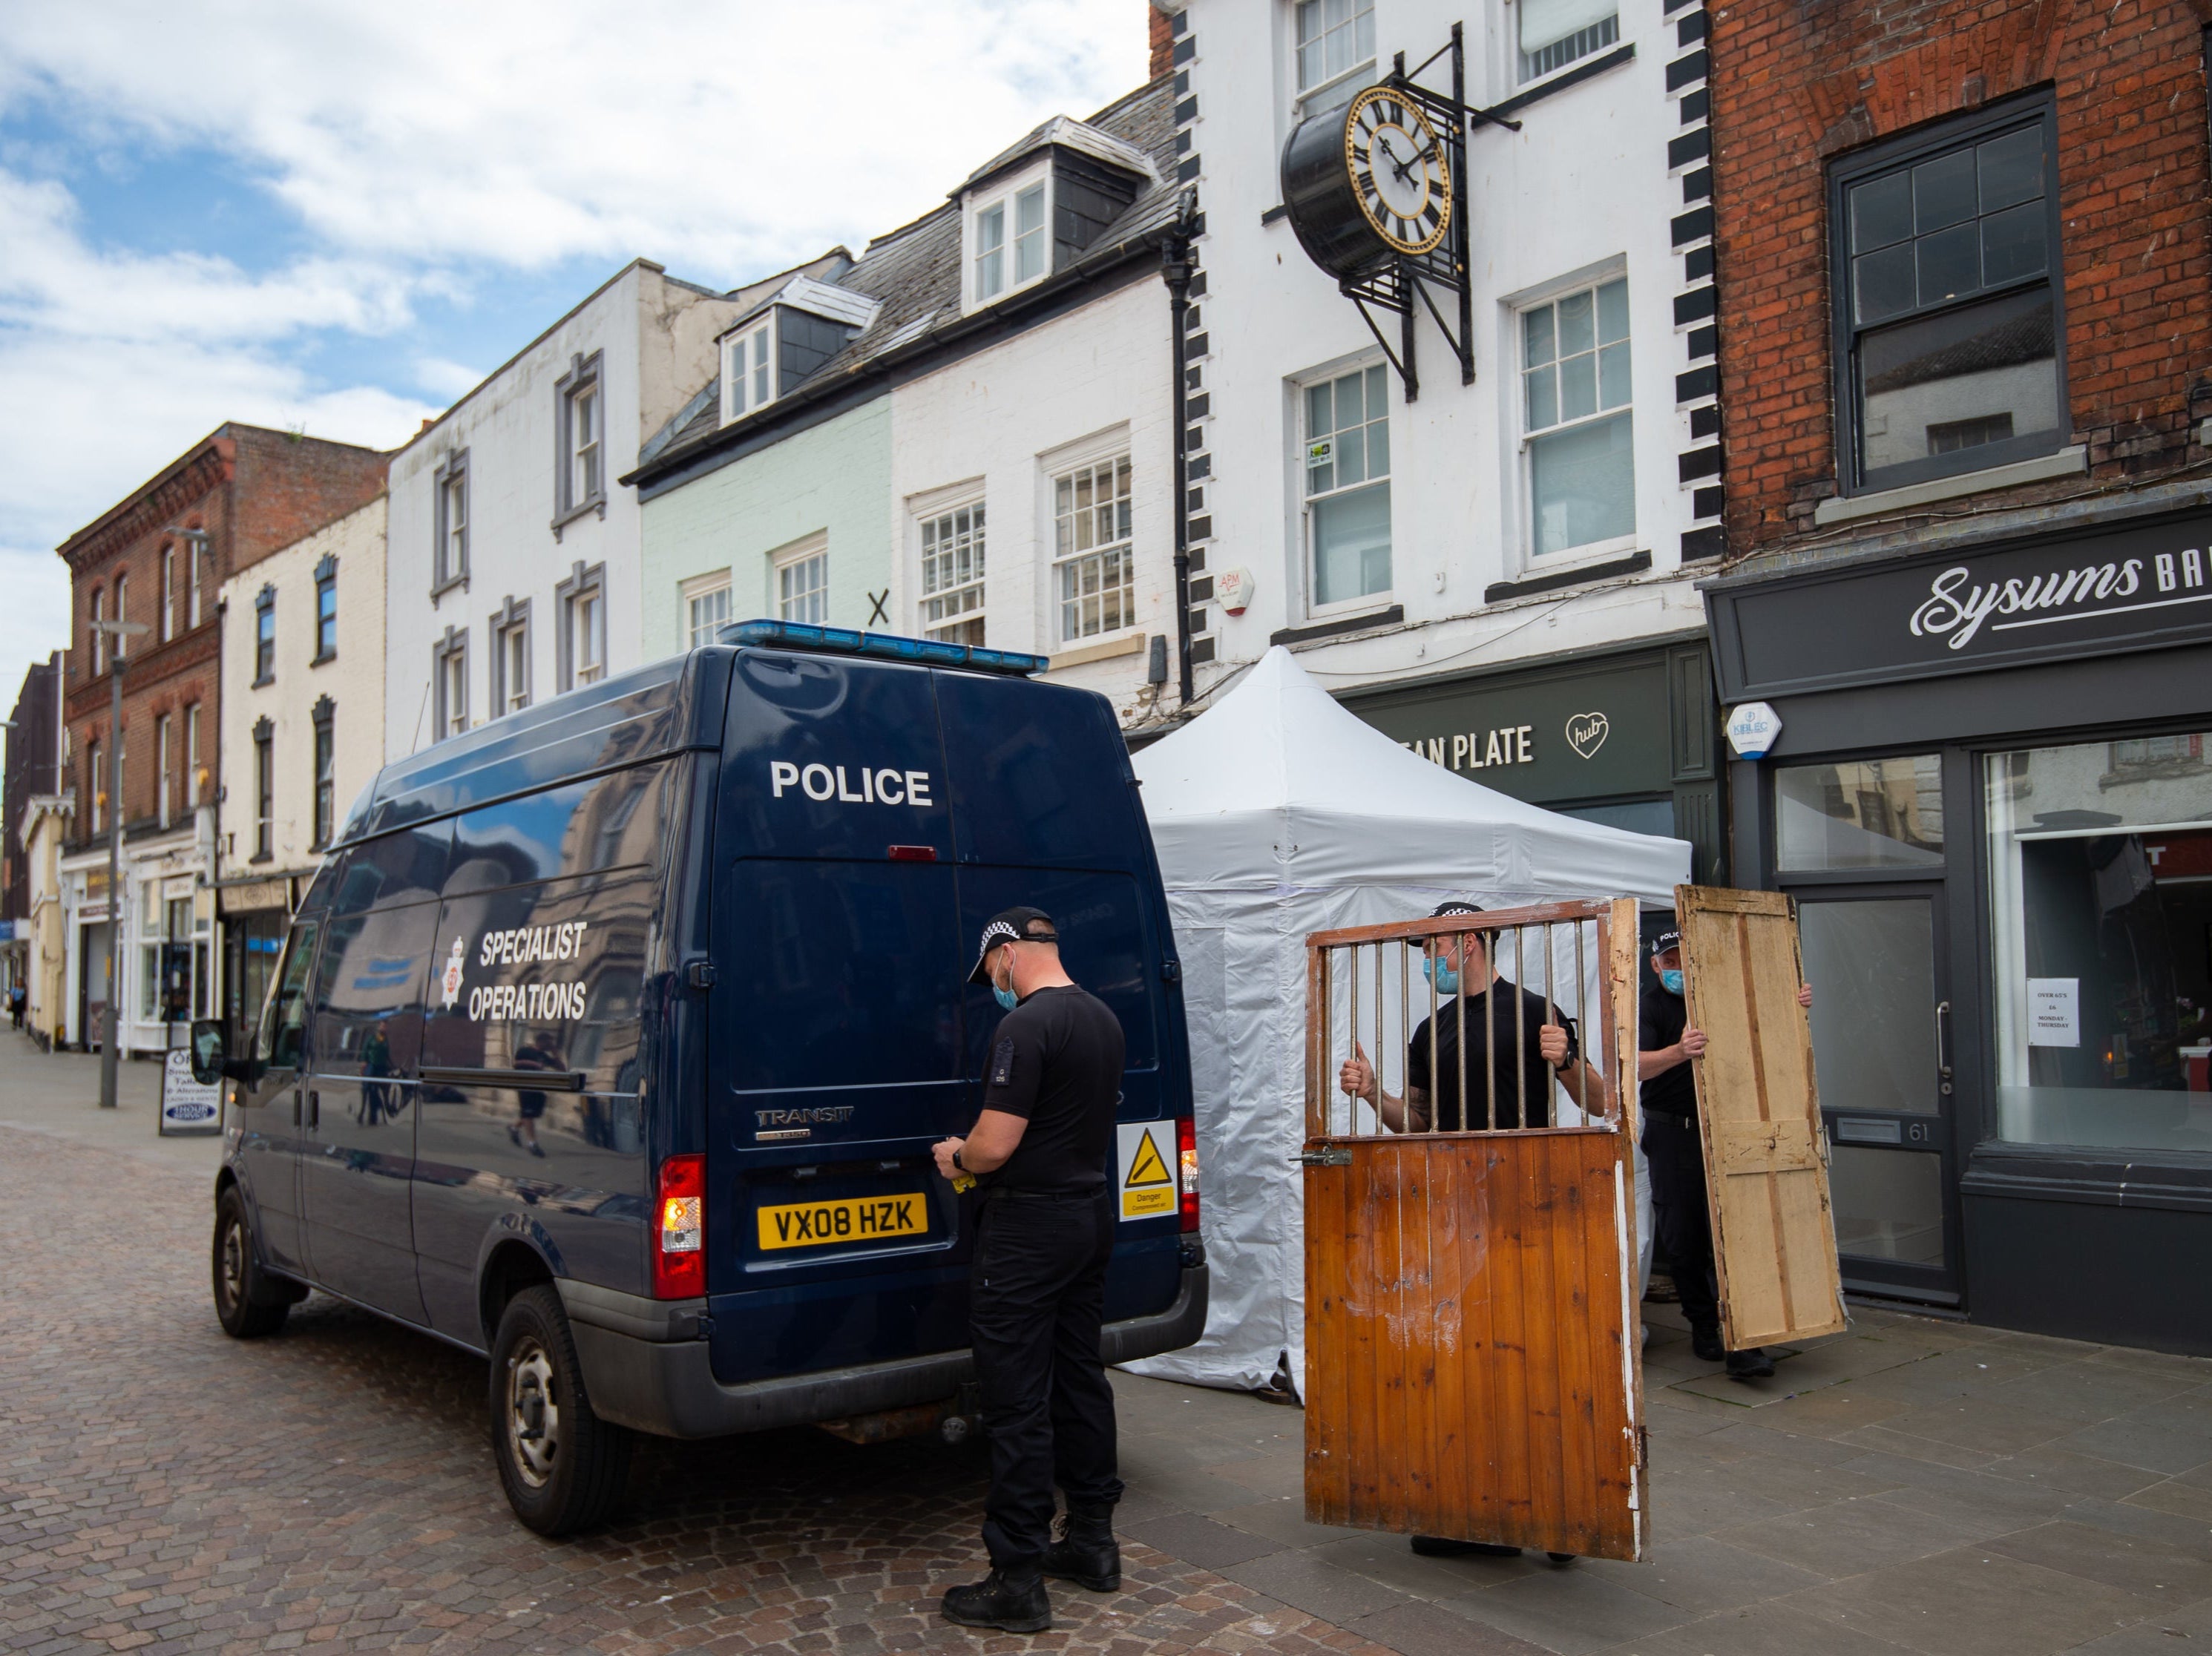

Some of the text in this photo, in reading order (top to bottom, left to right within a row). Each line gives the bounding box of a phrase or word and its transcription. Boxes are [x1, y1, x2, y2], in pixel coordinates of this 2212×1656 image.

[1910, 546, 2212, 649] Sysums BA
[1454, 725, 1534, 770] PLATE
[1575, 719, 1601, 746] hub
[770, 760, 933, 806] POLICE
[480, 921, 587, 967] SPECIALIST
[1660, 931, 1679, 942] POLIC
[469, 981, 586, 1022] OPERATIONS
[755, 1105, 855, 1126] TRANSIT
[1909, 1123, 1929, 1141] 61
[1136, 1193, 1161, 1202] Danger
[775, 1200, 913, 1242] VX08 HZK
